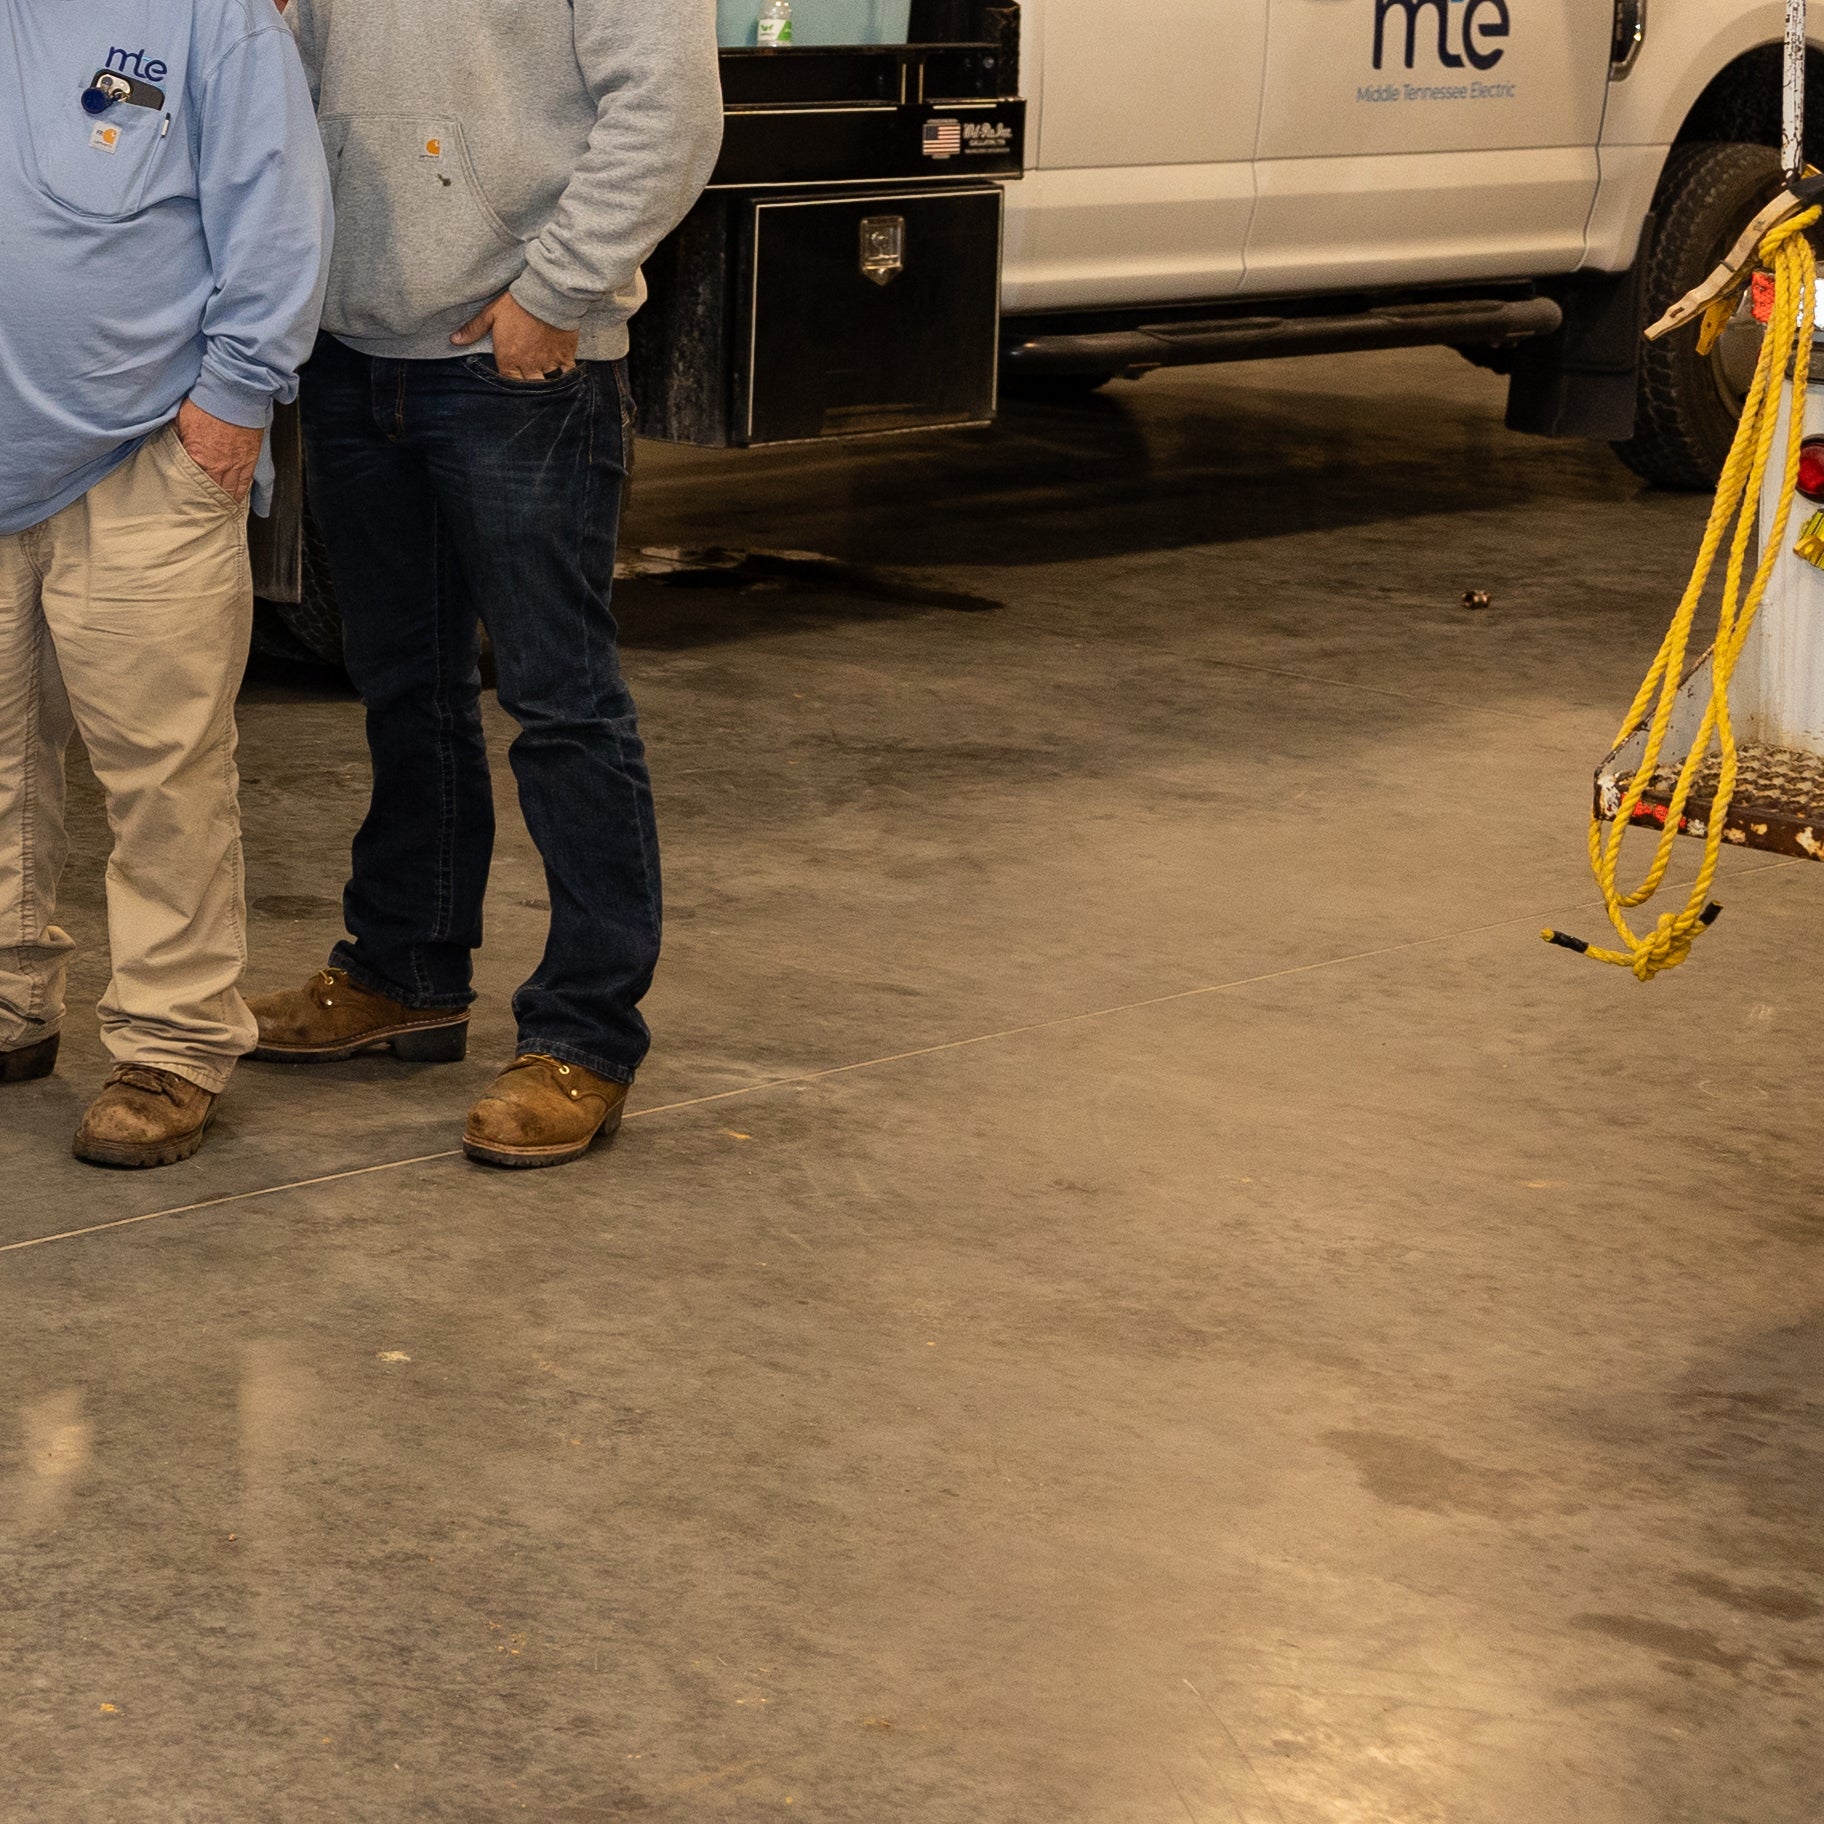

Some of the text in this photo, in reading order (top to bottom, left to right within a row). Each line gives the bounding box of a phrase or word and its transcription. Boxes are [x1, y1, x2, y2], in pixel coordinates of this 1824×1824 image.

[105, 46, 168, 82] mte
[1356, 81, 1516, 103] Middle Tennessee Electric
